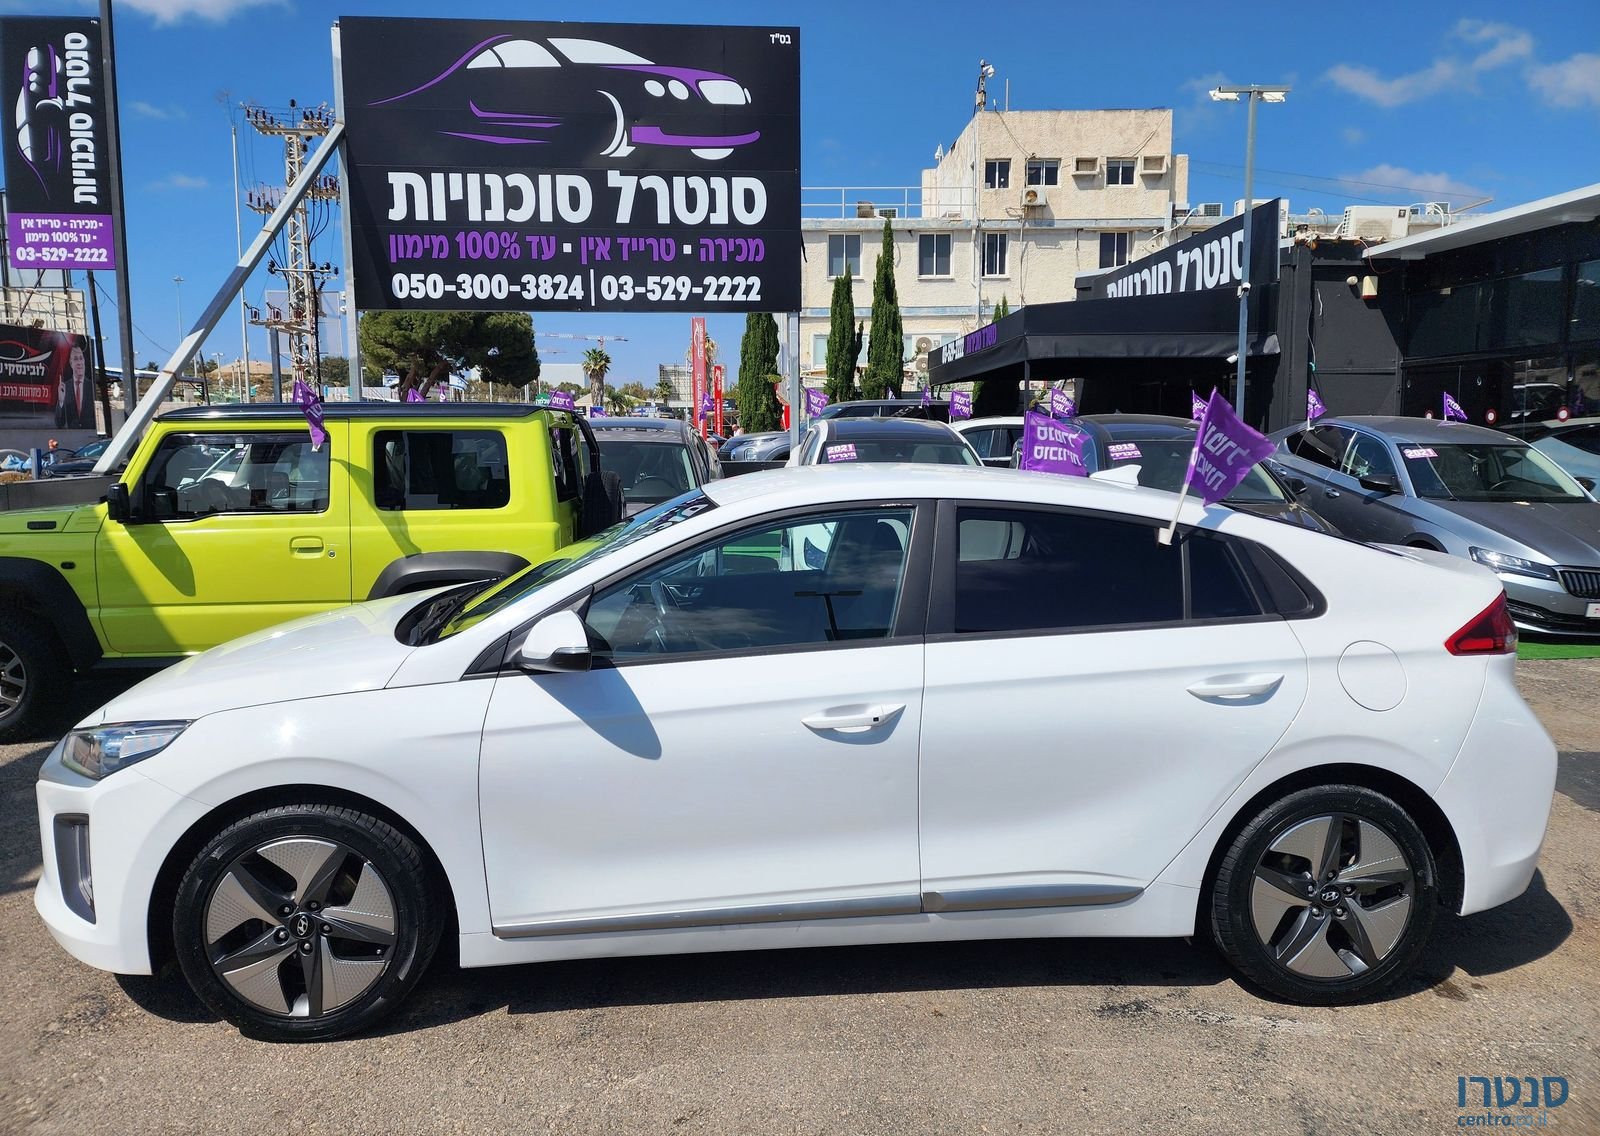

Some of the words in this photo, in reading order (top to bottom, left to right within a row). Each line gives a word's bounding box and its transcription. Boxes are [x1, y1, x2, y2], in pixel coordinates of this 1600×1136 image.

[770, 33, 791, 44] בס"ד
[64, 32, 92, 107] סנטרל
[69, 112, 98, 205] סוכנויות
[387, 171, 593, 223] סוכנויות
[607, 169, 768, 225] סנטרל
[20, 218, 34, 230] אין
[36, 218, 61, 229] טרייד
[69, 219, 98, 229] מכירה
[25, 232, 50, 244] מימון
[51, 231, 78, 243] 100%
[79, 232, 91, 243] עד
[455, 231, 521, 260] 100%
[16, 246, 108, 262] 03-529-2222
[389, 233, 449, 263] מימון
[525, 235, 557, 261] עד
[579, 236, 611, 265] אין
[617, 236, 676, 262] טרייד
[699, 237, 765, 262] מכירה
[1176, 229, 1244, 292] סנטרל
[392, 272, 584, 300] 050-300-3824
[600, 274, 761, 301] 03-529-2222
[4, 362, 46, 376] לובינסקי
[827, 443, 855, 454] 2021
[1108, 442, 1137, 452] 2019
[1405, 448, 1437, 458] 2021
